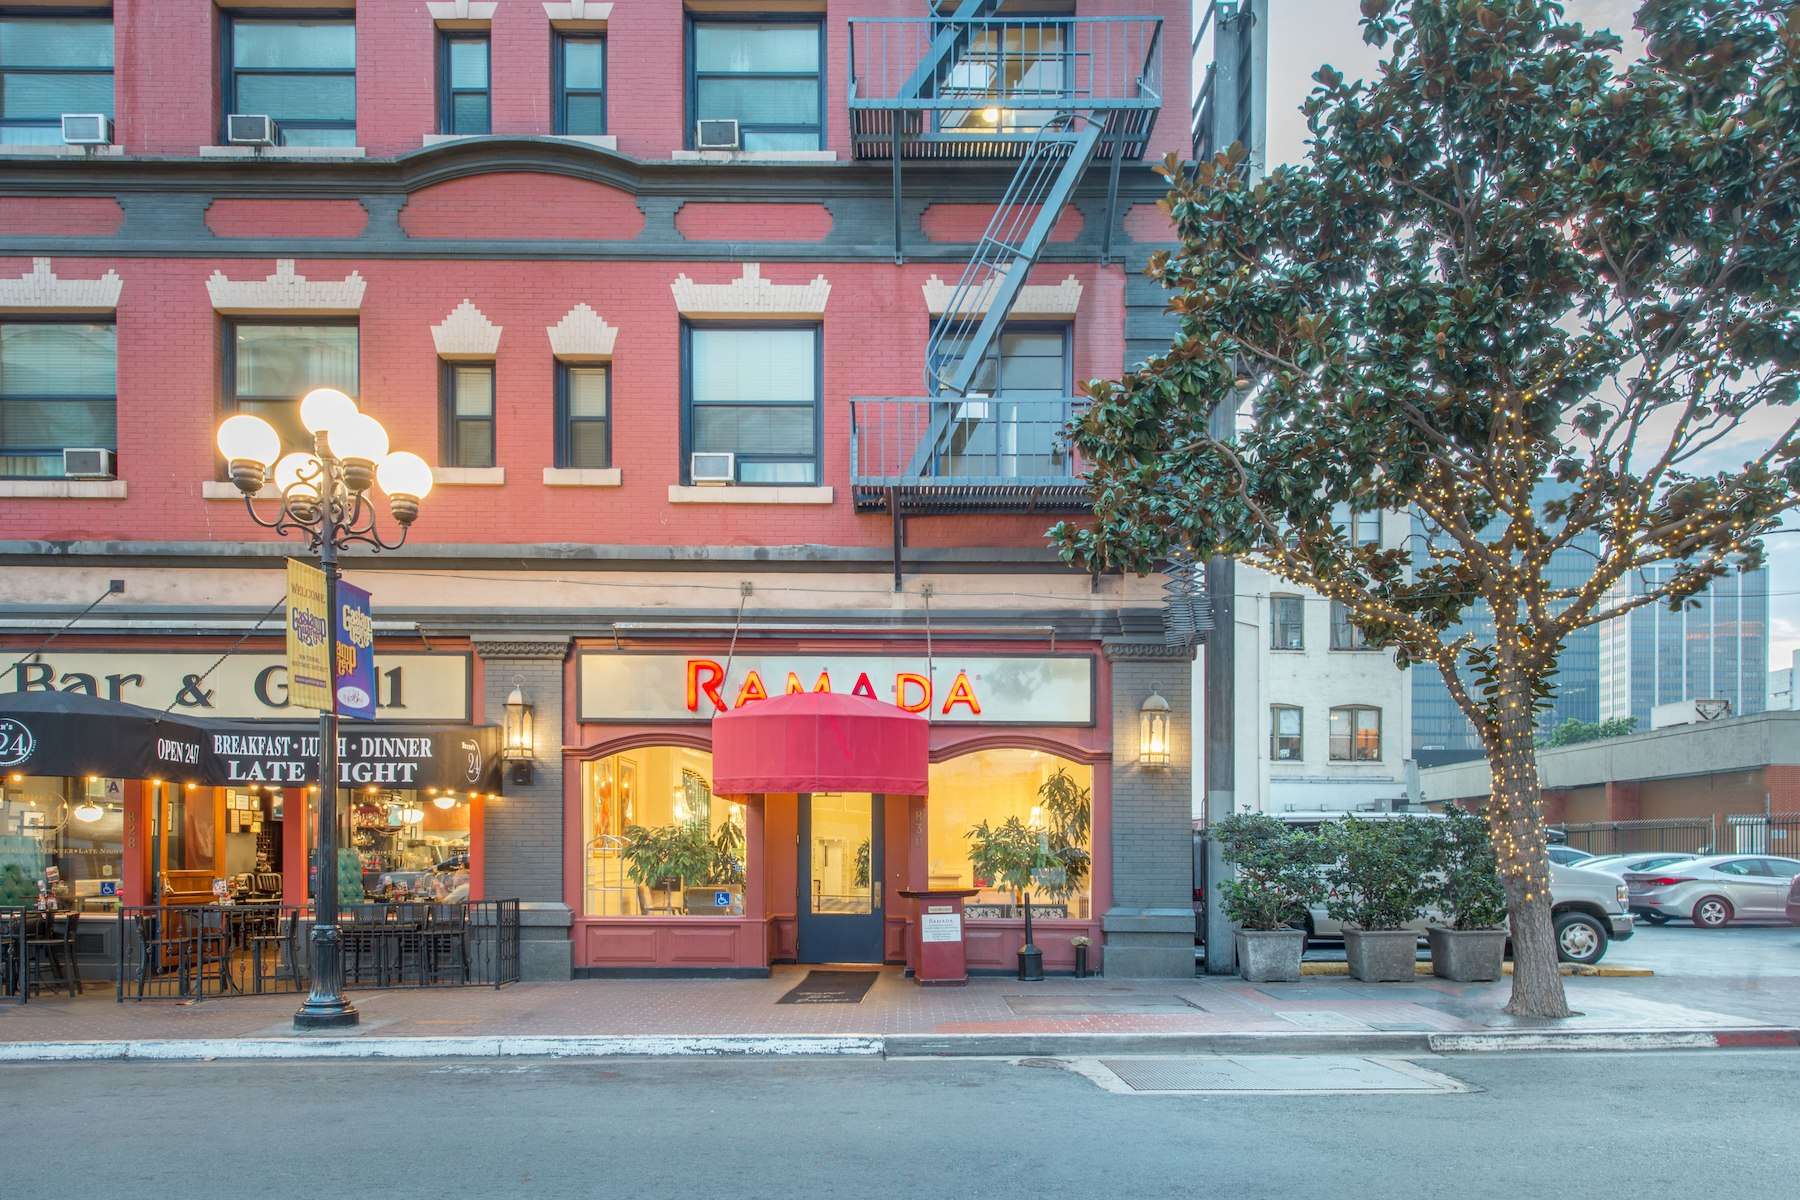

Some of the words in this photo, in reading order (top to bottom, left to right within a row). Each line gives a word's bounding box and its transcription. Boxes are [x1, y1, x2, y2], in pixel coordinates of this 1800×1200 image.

[13, 662, 145, 703] Bar
[176, 673, 215, 708] &
[686, 659, 982, 715] RAMADA
[157, 738, 184, 762] OPEN
[185, 741, 200, 765] 24/7
[214, 735, 291, 757] BREAKFAST
[301, 737, 347, 758] LUH
[360, 738, 433, 758] DINNER
[227, 761, 305, 783] LATE
[317, 762, 418, 784] IGHT
[468, 752, 480, 774] 24
[109, 781, 119, 793] A
